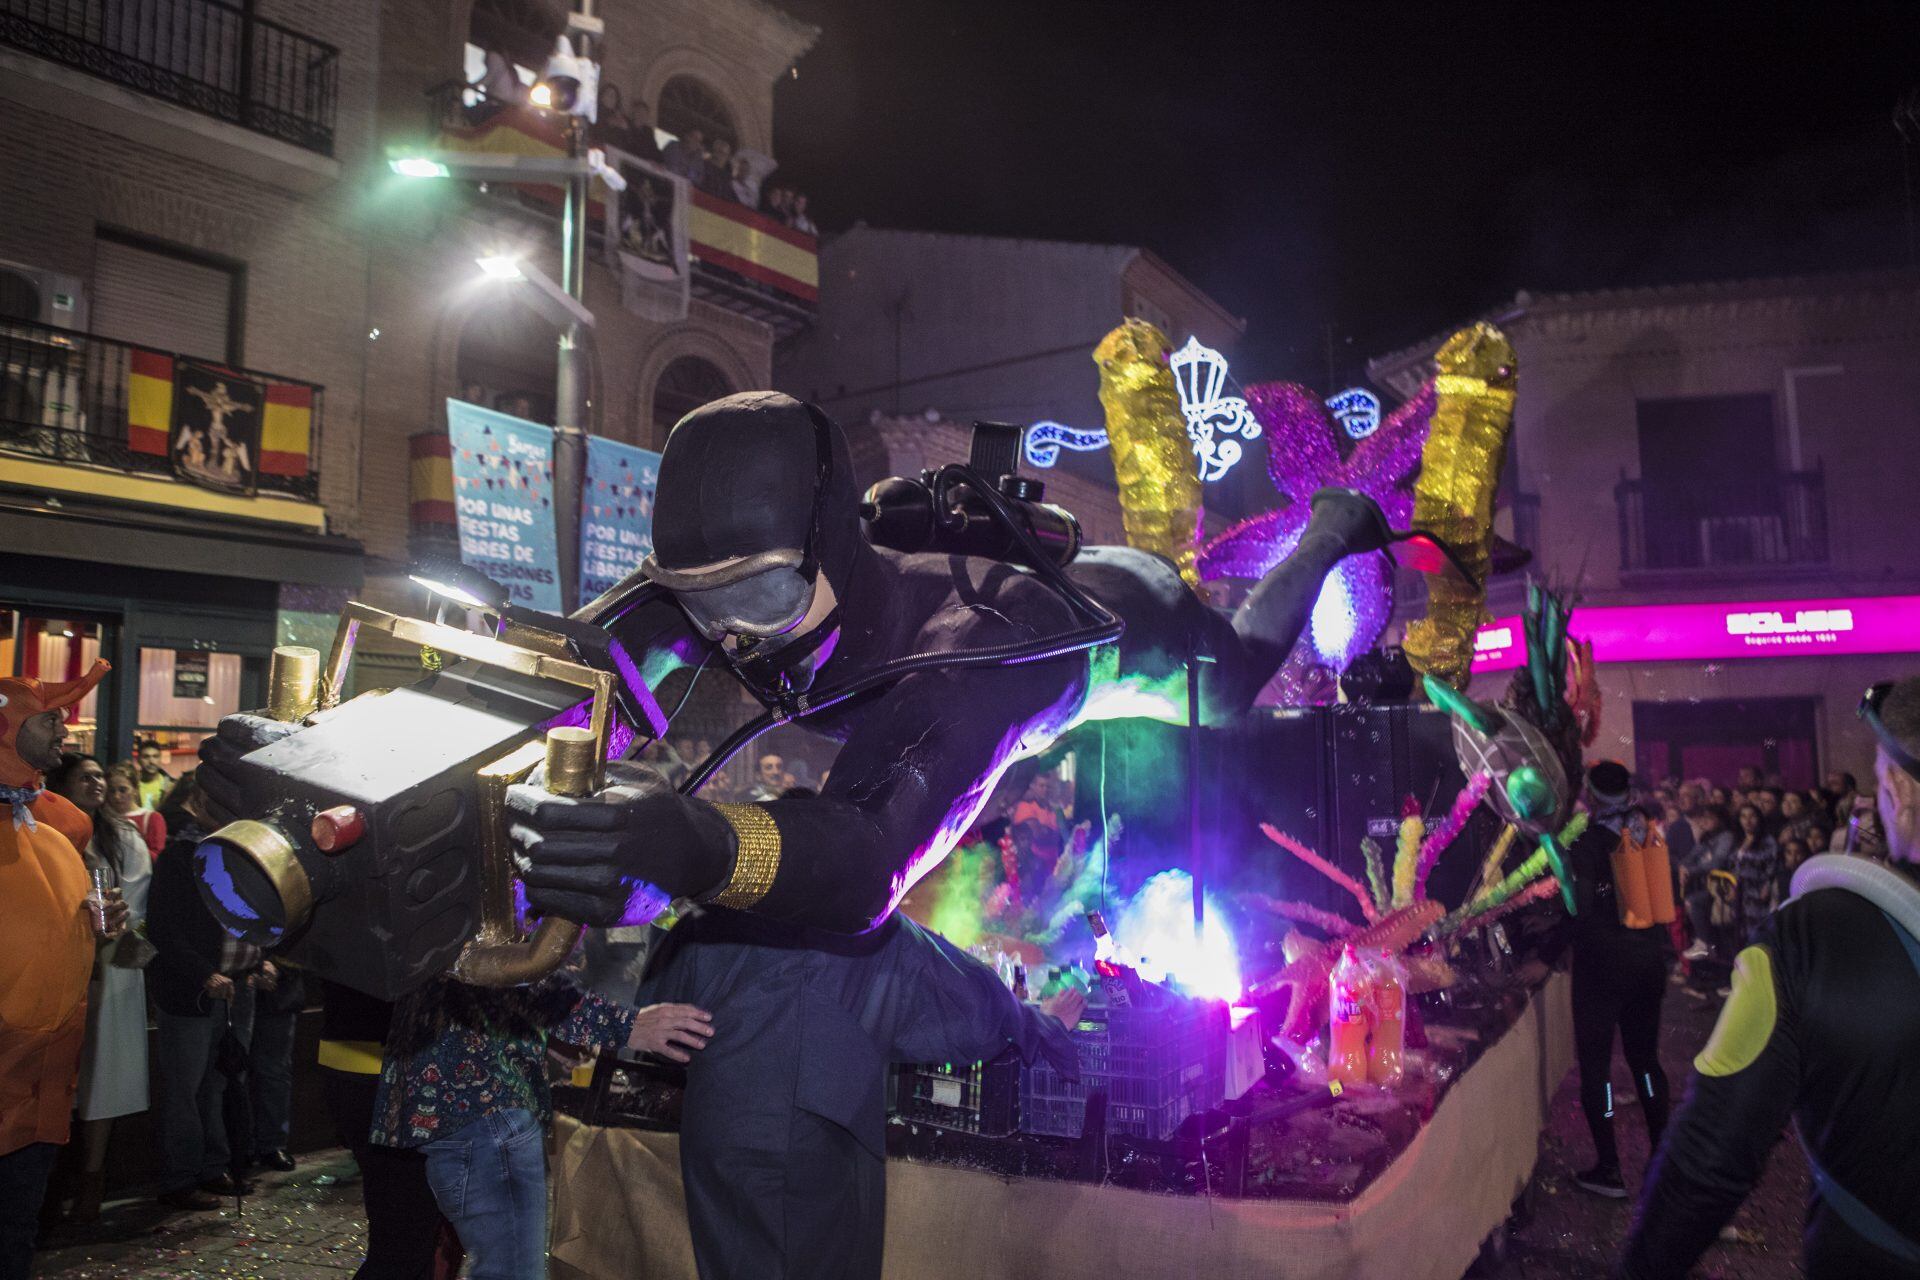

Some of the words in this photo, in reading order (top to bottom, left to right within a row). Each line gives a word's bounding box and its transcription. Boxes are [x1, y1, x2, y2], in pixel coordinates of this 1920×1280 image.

[491, 503, 534, 526] UNAS
[586, 522, 616, 541] POR
[619, 529, 654, 549] UNA
[513, 544, 535, 563] DE
[584, 540, 644, 564] FIESTAS
